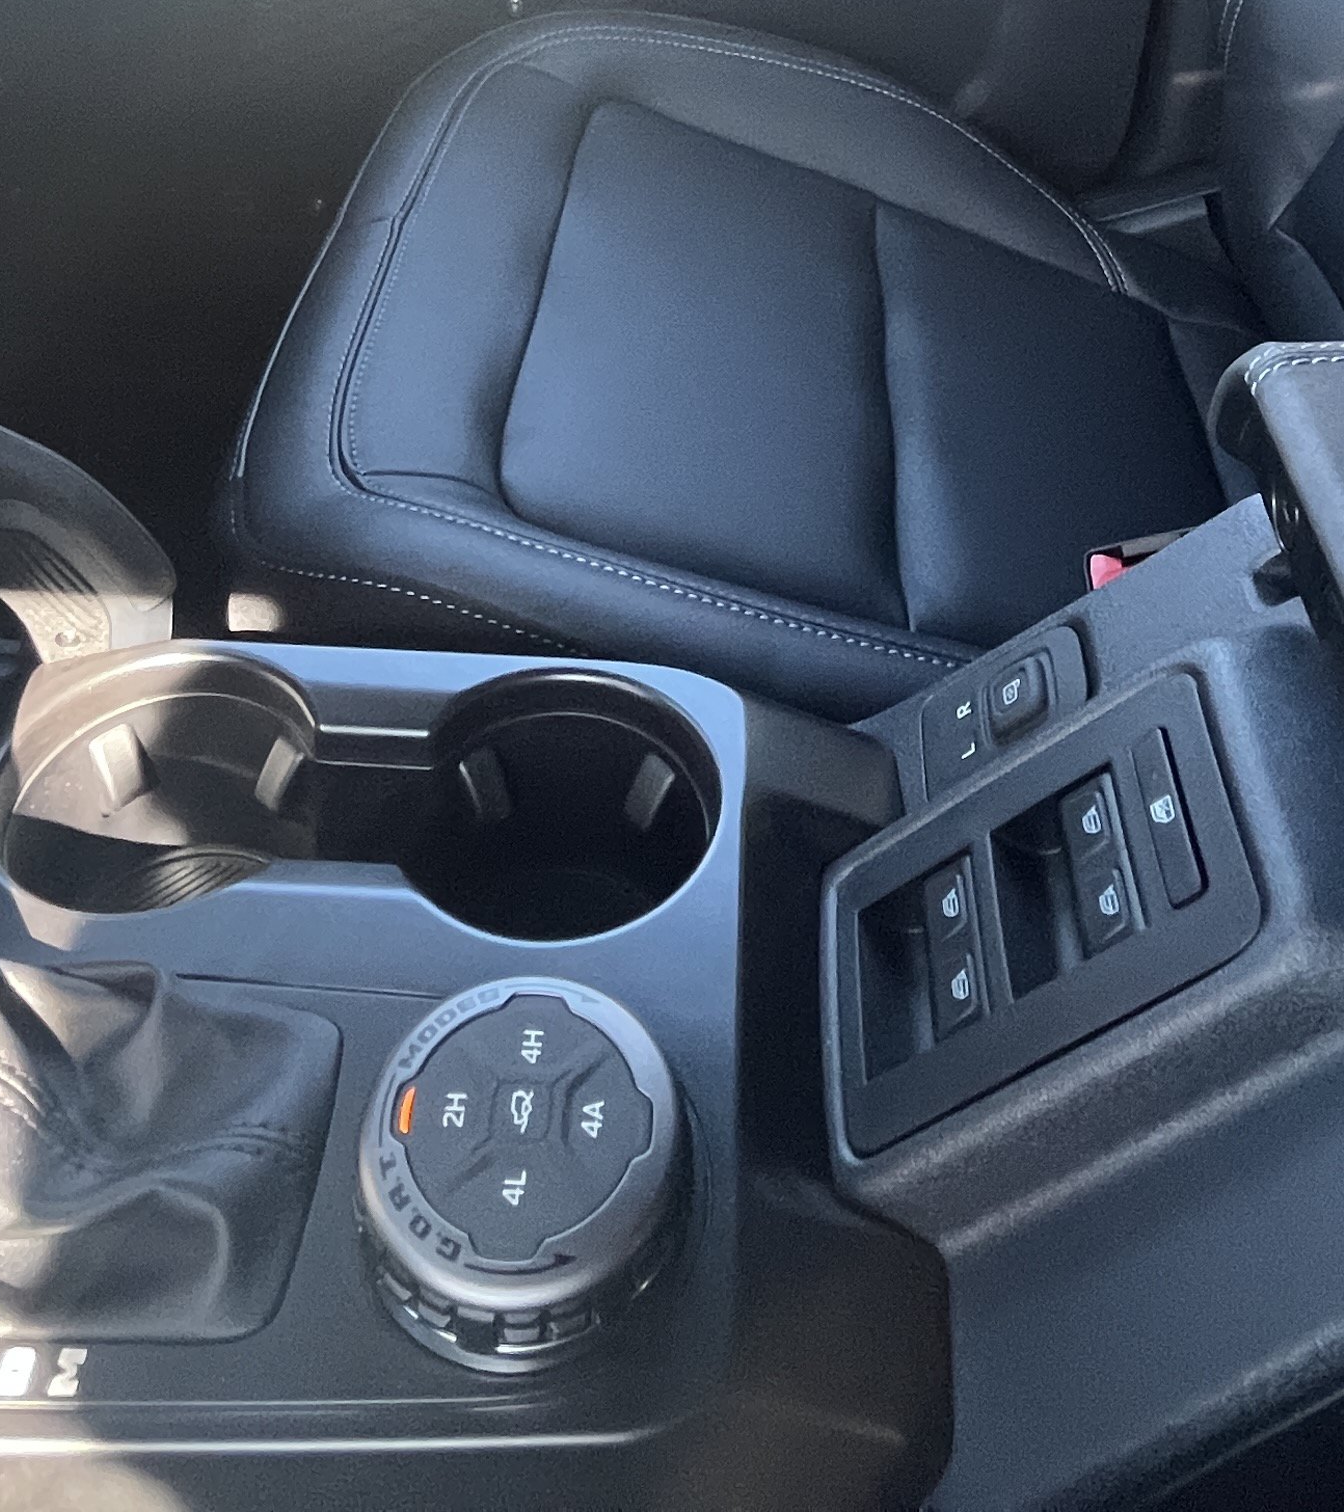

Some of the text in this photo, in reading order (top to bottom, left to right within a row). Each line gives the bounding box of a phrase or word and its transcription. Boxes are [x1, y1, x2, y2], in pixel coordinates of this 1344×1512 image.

[957, 701, 972, 719] R
[961, 742, 976, 760] L
[397, 987, 502, 1071] MODES
[520, 1028, 545, 1065] 4H
[442, 1091, 468, 1128] 2H
[580, 1099, 606, 1139] 4A
[502, 1169, 527, 1206] 4L
[46, 1347, 88, 1398] M
